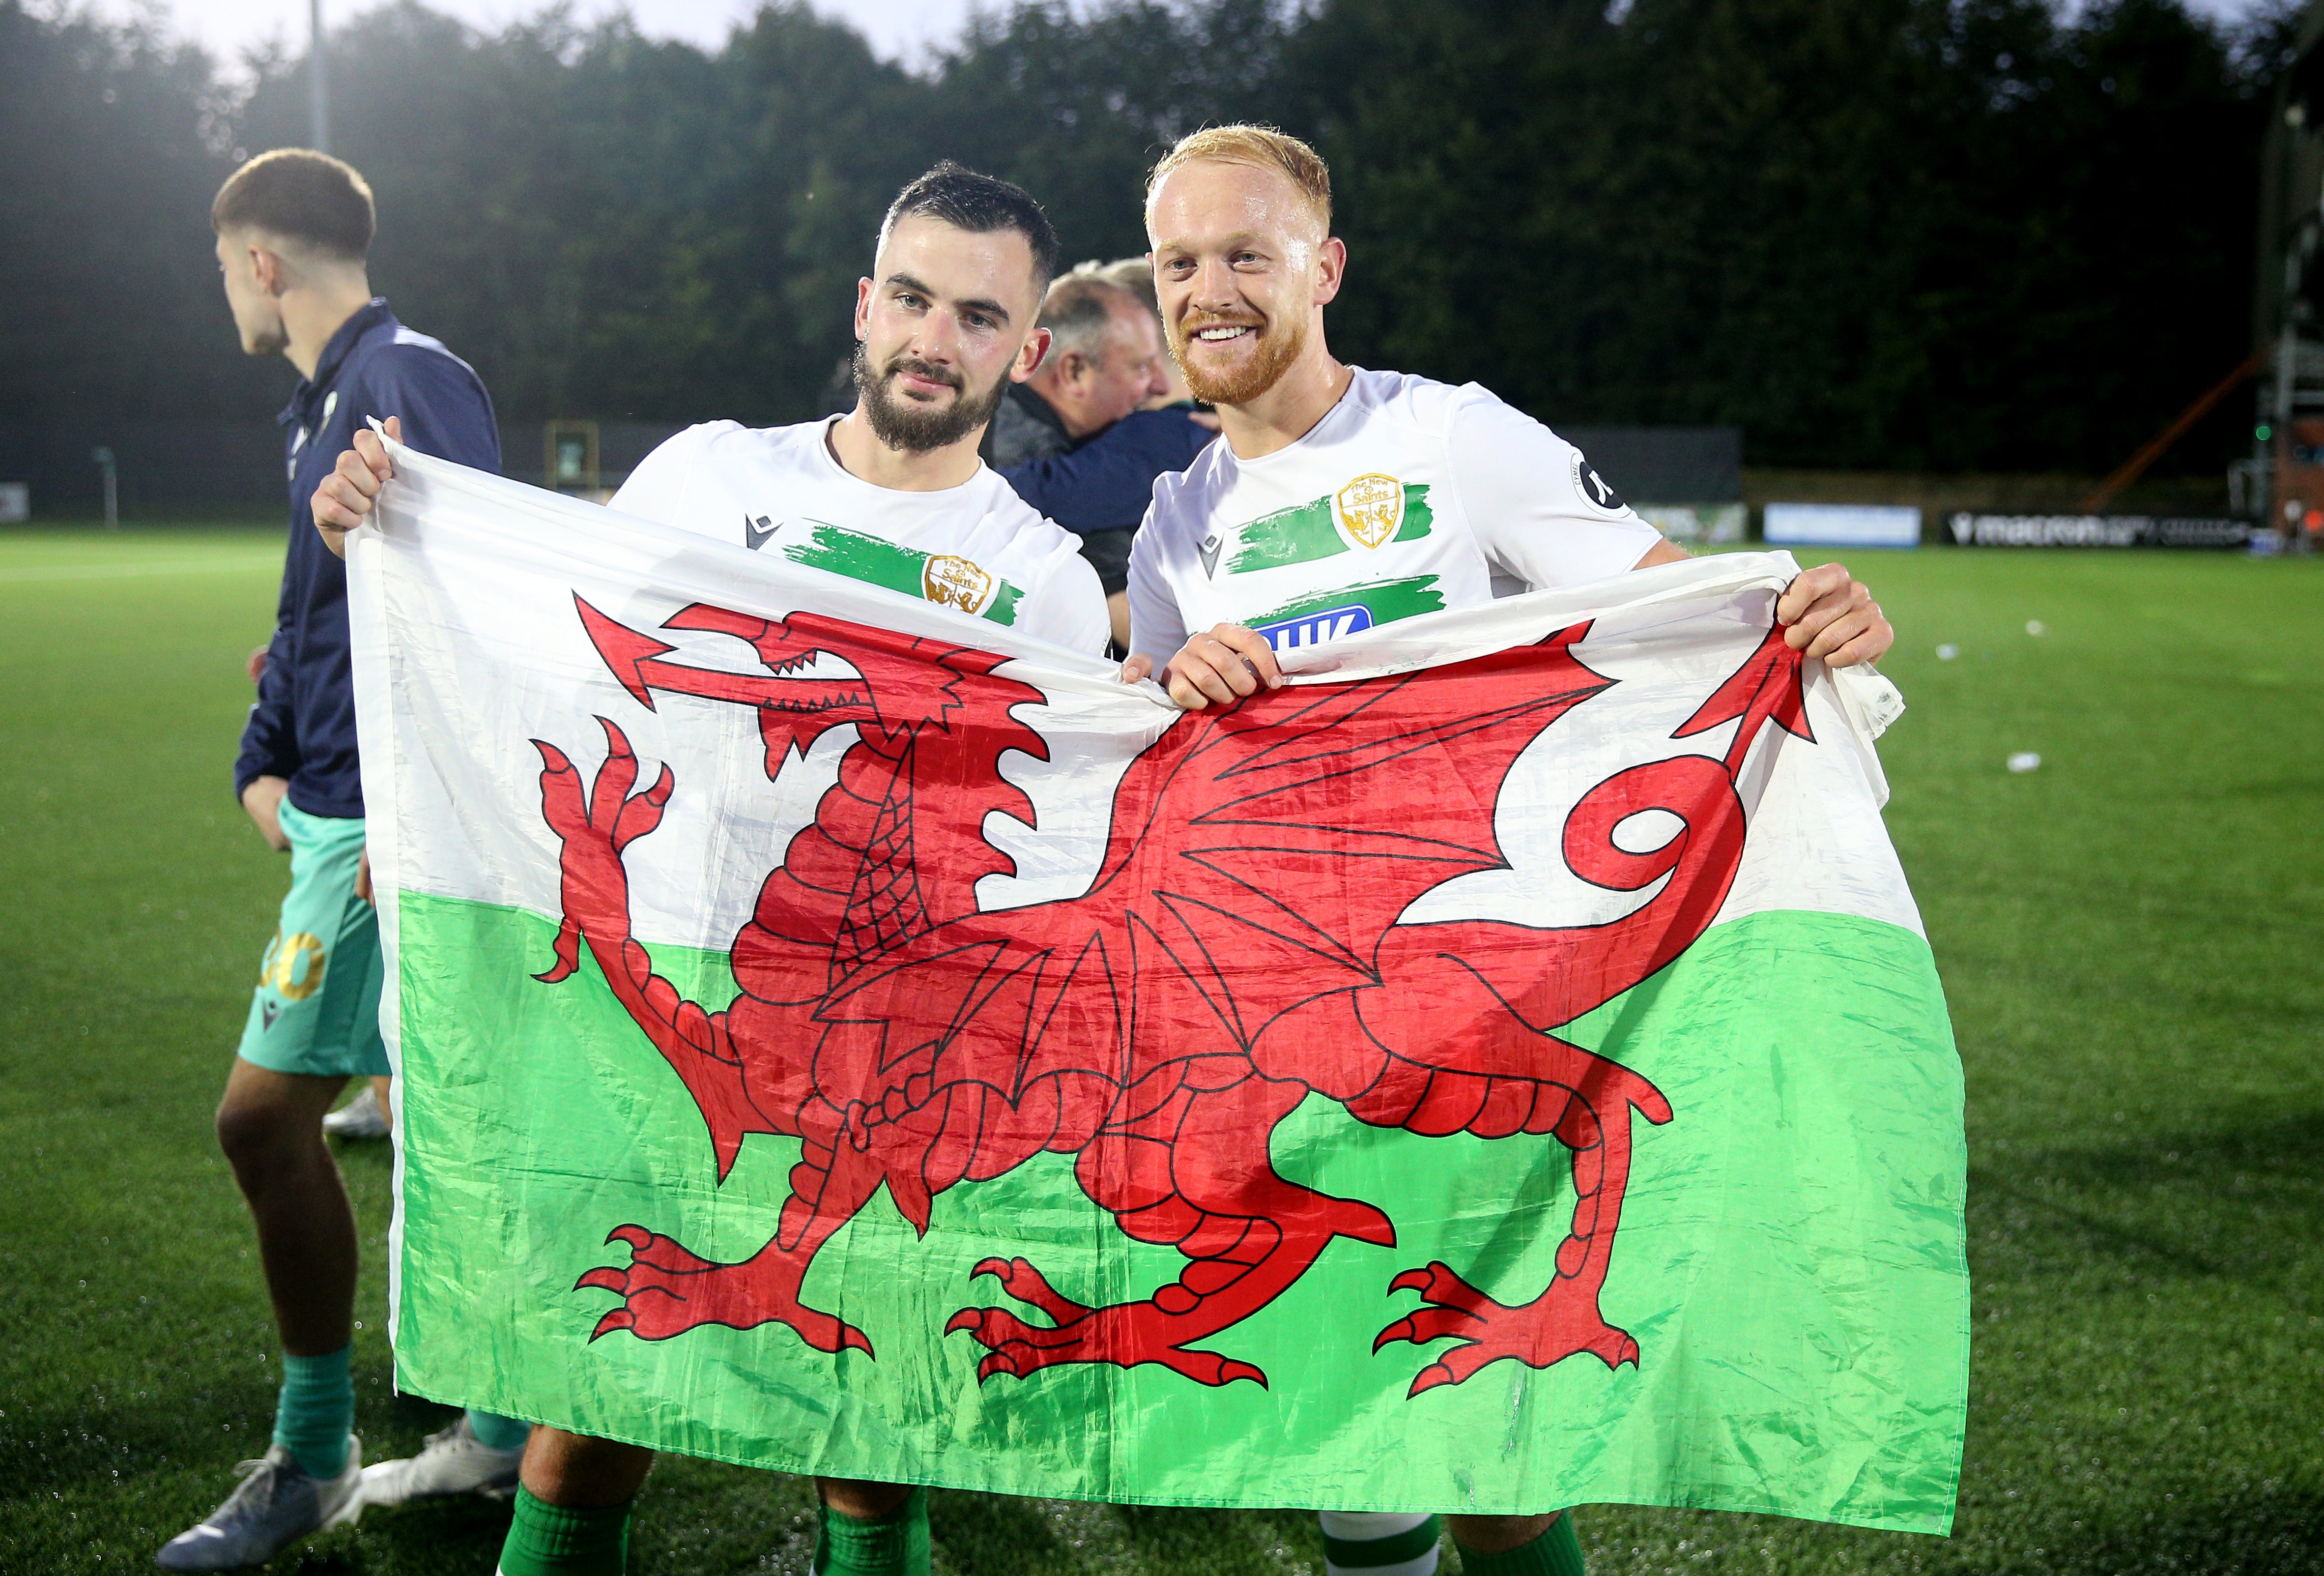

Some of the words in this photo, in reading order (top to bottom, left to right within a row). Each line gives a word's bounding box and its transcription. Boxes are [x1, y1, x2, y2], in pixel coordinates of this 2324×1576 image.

[1573, 463, 1581, 485] CYMRU
[1351, 482, 1367, 493] The
[1369, 478, 1388, 486] New
[1353, 491, 1389, 504] Saints
[944, 560, 962, 569] The
[942, 568, 978, 589] Saints
